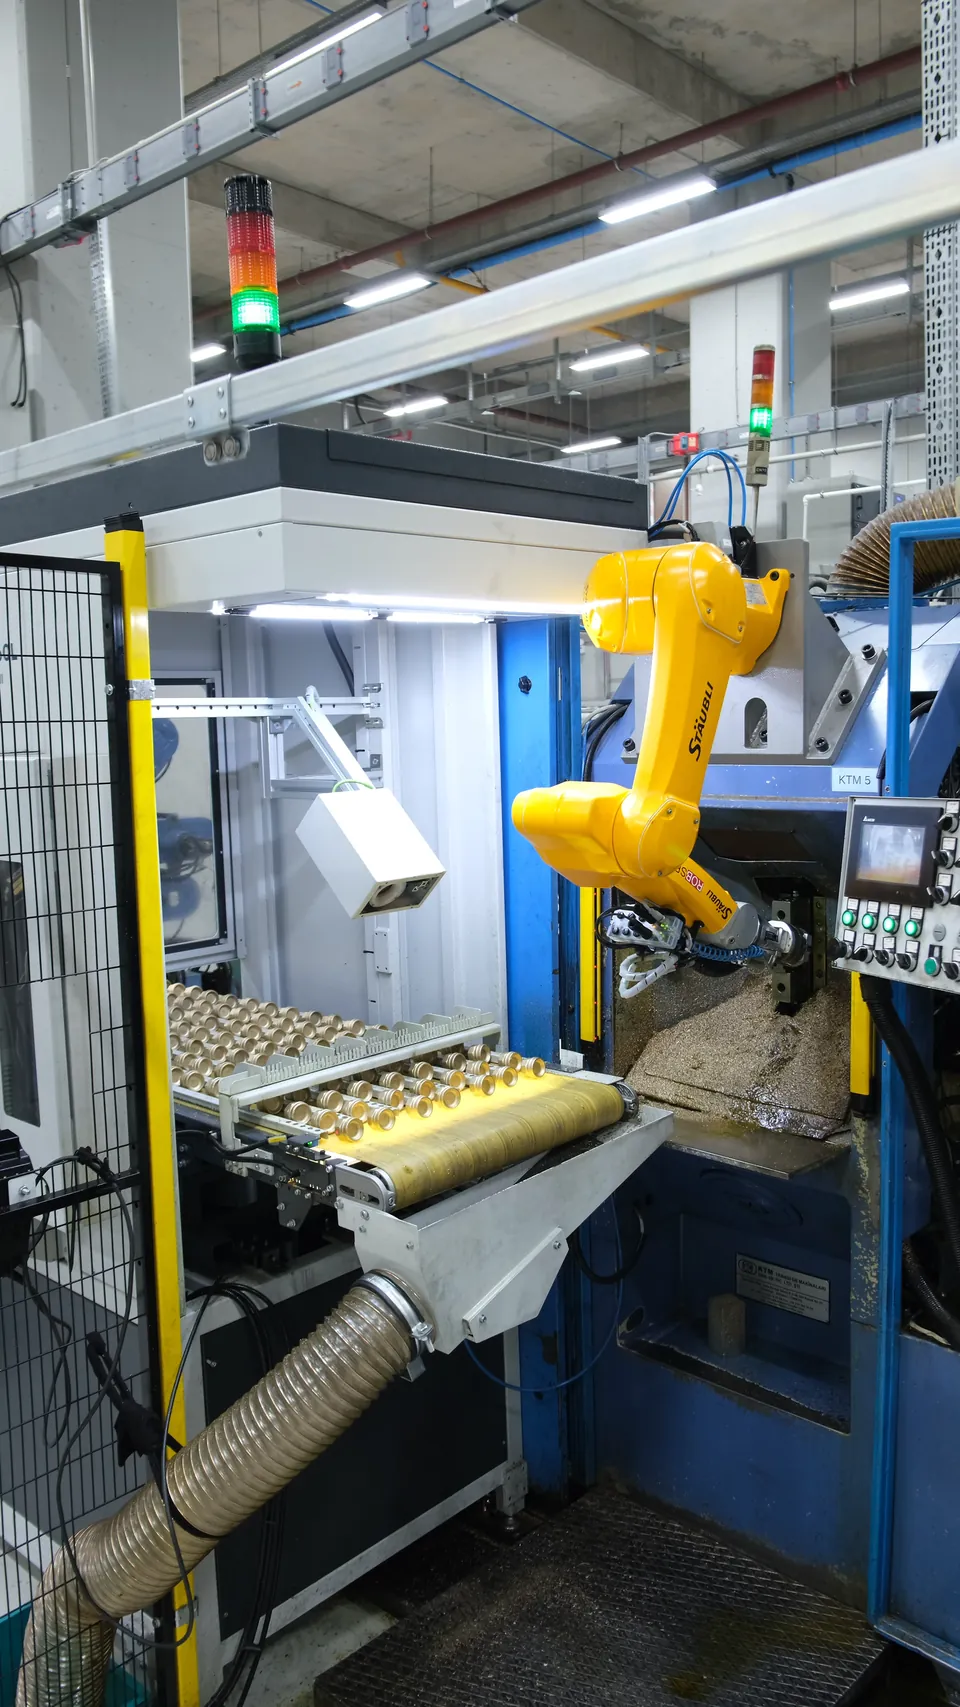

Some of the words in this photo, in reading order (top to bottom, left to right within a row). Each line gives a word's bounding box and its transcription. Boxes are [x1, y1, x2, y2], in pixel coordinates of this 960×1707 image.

[688, 681, 714, 762] STÄUBLI
[838, 774, 862, 785] KTM
[864, 775, 872, 786] 5
[706, 889, 733, 920] STÄUBLI
